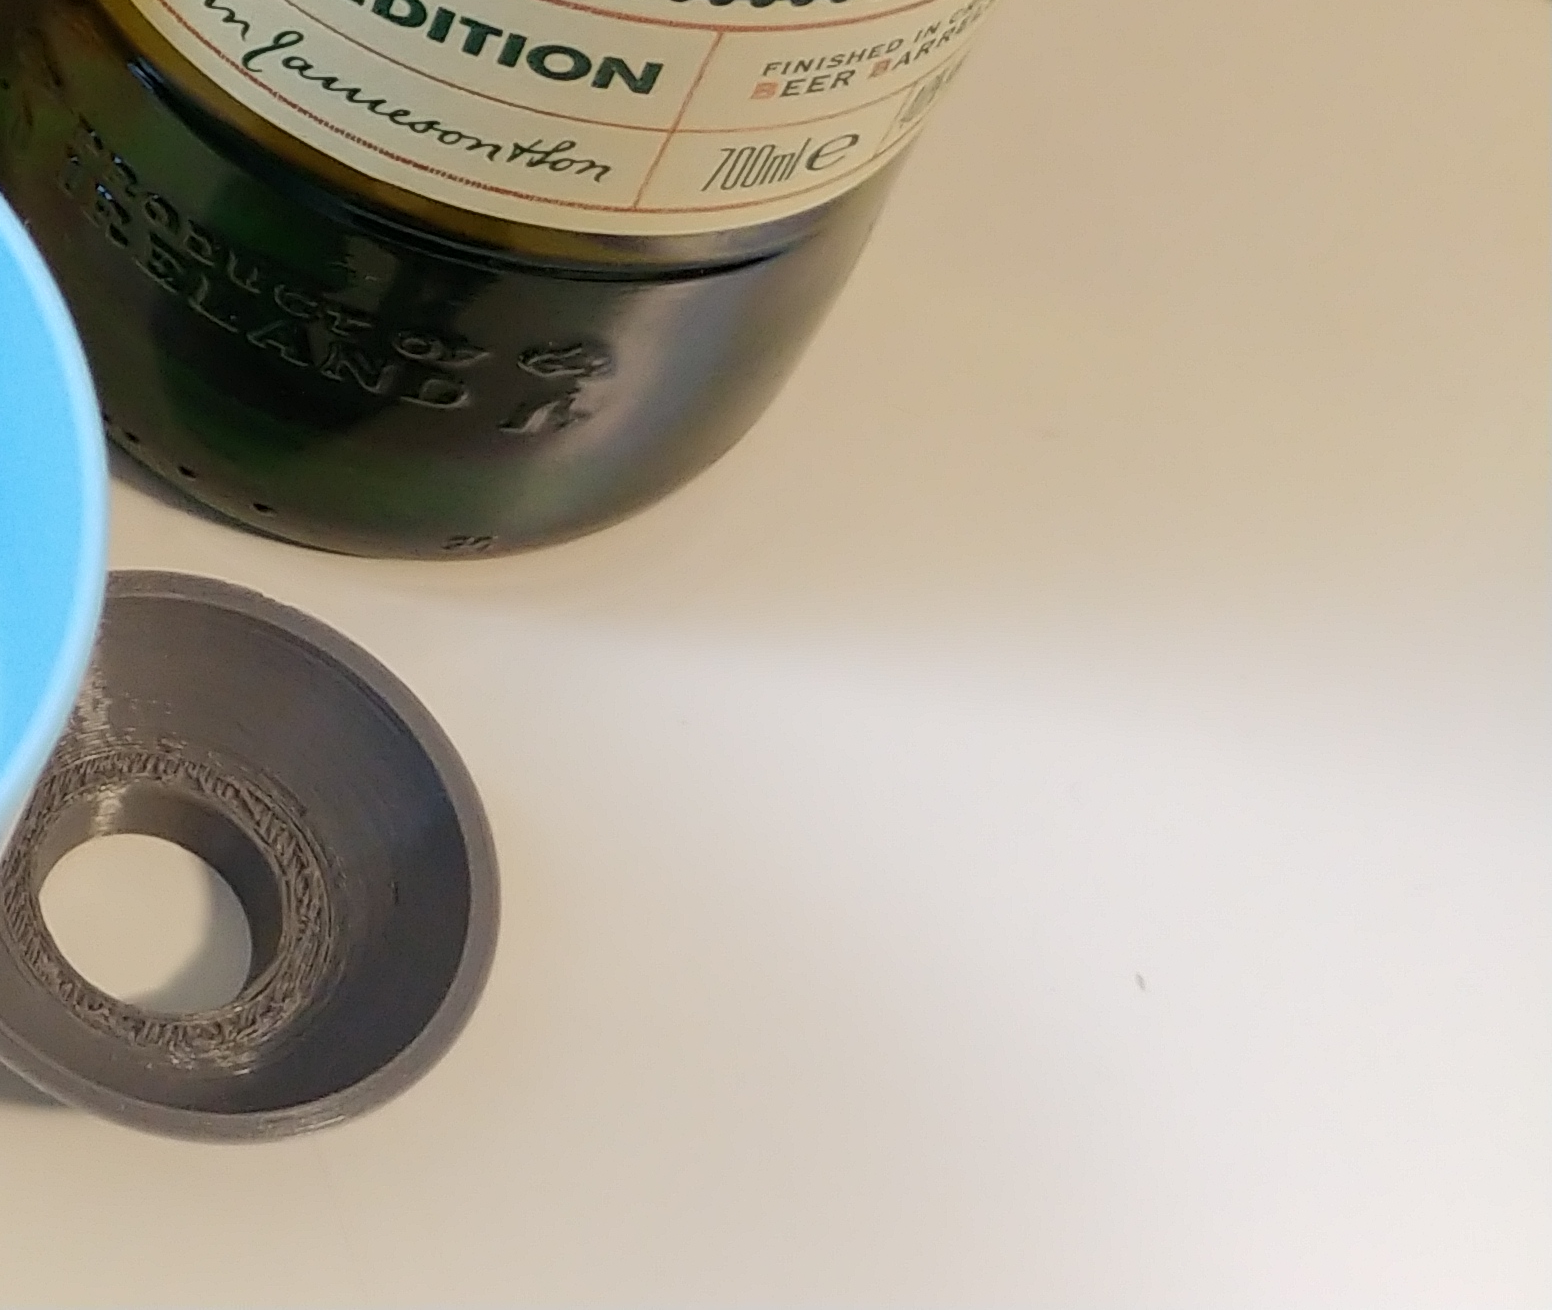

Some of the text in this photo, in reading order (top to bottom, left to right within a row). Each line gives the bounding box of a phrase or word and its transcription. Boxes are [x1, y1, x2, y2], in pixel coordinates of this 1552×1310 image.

[762, 38, 904, 78] FINISHED
[913, 20, 942, 44] IN
[241, 30, 502, 161] Jameson
[750, 68, 857, 101] BEER
[700, 137, 812, 193] 700ml
